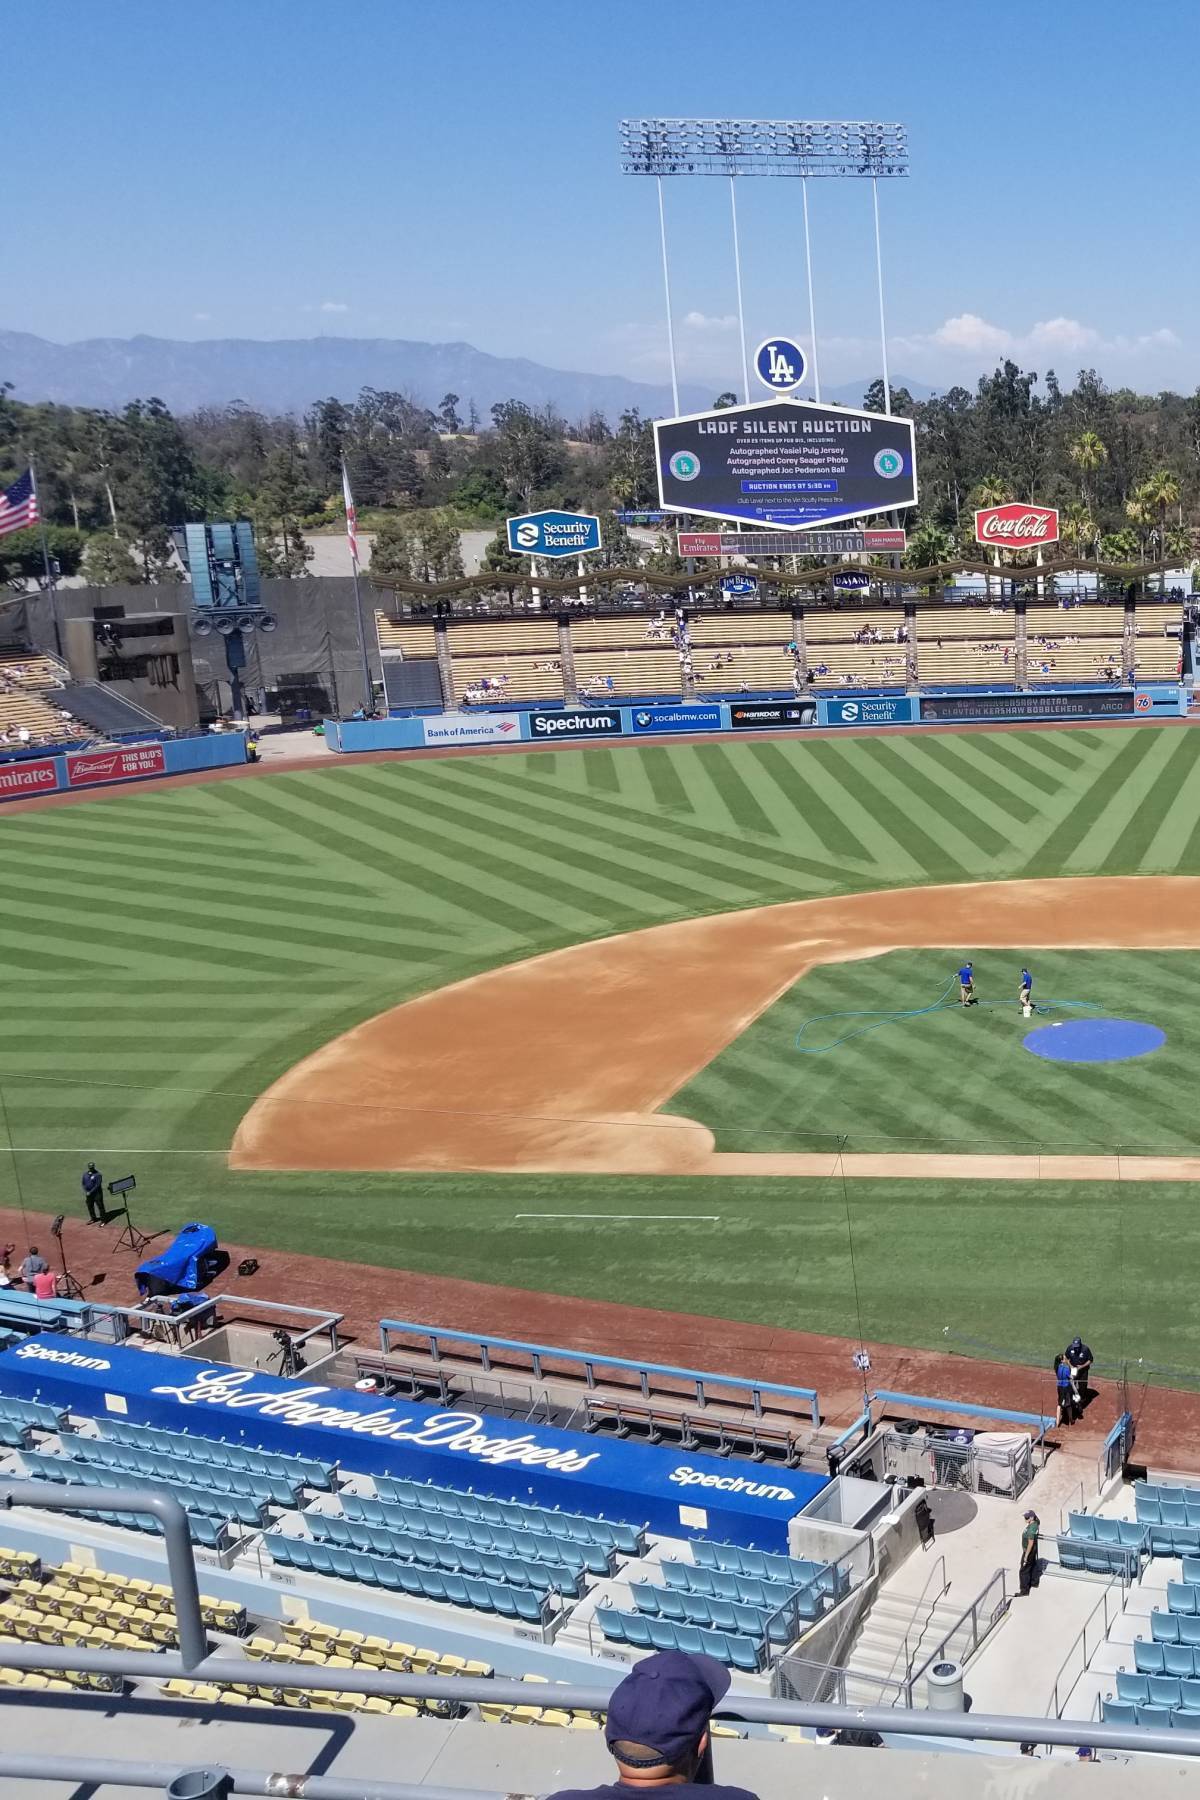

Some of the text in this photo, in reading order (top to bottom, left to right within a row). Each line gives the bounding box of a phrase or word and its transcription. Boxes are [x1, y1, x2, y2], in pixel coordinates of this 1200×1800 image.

[767, 346, 794, 382] LA
[698, 420, 872, 434] LADF SILENT AUCTION
[729, 446, 845, 456] Autographed Yasiel Puig Jersey
[727, 456, 849, 466] Autographed Corey Seager Photo
[731, 466, 846, 476] Autographed Joc Pederson Ball
[543, 521, 592, 535] Security
[545, 534, 585, 547] Benefit
[683, 544, 719, 552] Emirates
[722, 578, 735, 591] JIM
[735, 575, 755, 589] BEAM
[835, 576, 868, 585] DASANI
[862, 702, 897, 713] Security
[1101, 703, 1122, 711] ARCO
[1137, 699, 1149, 708] 76
[862, 711, 893, 720] Benefit
[983, 707, 1024, 715] KERSHAW
[654, 712, 717, 723] socalbmw.com
[535, 715, 611, 733] Spectrum
[427, 726, 494, 737] Bank of America
[121, 750, 162, 762] THIS BUD'S
[122, 760, 156, 772] FOR YOU.
[0, 768, 54, 788] mirates
[16, 1343, 110, 1370] Spectrum
[151, 1370, 600, 1472] Los Angeles Dodgers
[669, 1466, 794, 1500] Spectrum
